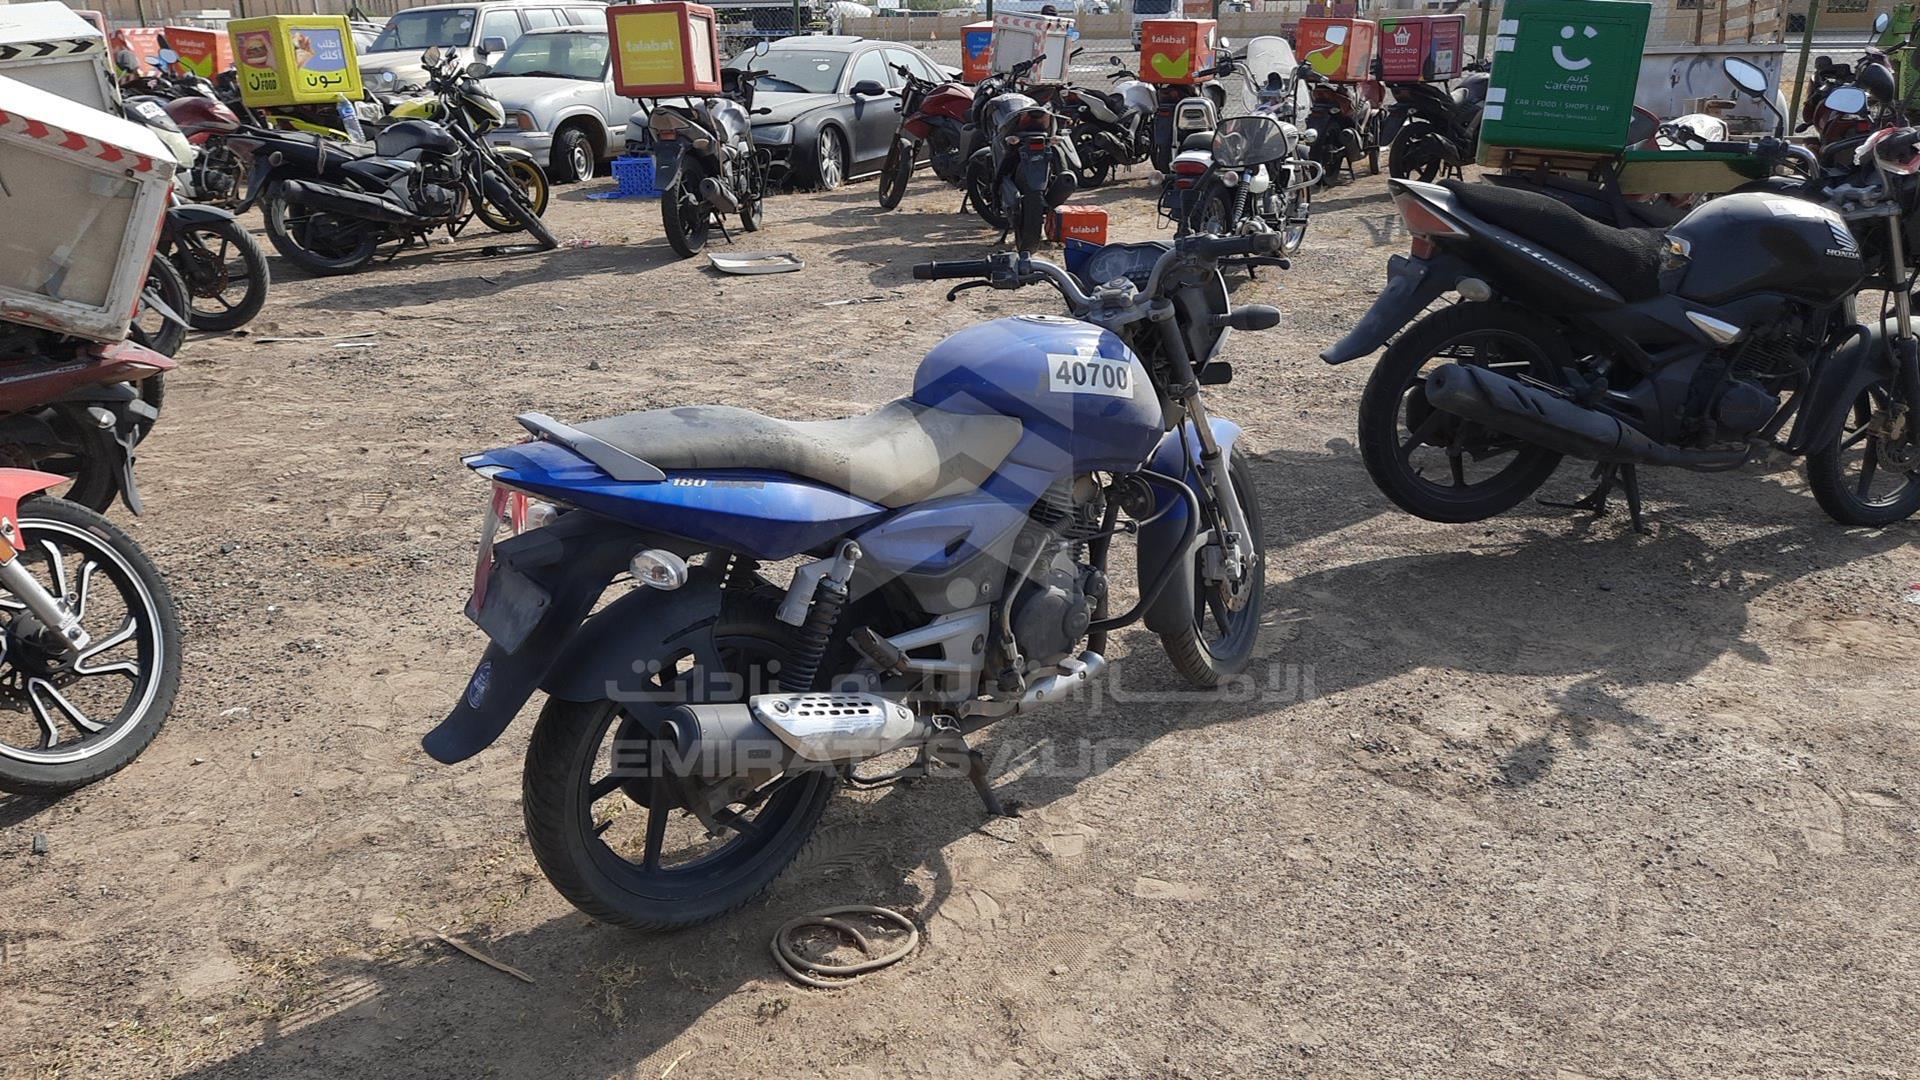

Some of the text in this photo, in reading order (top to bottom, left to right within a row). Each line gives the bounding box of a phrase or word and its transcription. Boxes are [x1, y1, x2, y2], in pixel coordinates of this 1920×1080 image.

[1152, 35, 1186, 44] talabat
[627, 39, 674, 52] talabat
[306, 72, 342, 88] نون
[1566, 75, 1590, 83] كريم
[261, 80, 277, 91] FOOD
[1544, 80, 1588, 92] Careem
[1564, 102, 1589, 110] SHOPS
[1071, 225, 1099, 233] talabat
[1826, 248, 1860, 259] HONDA
[1056, 361, 1127, 390] 40700
[672, 479, 707, 487] 180
